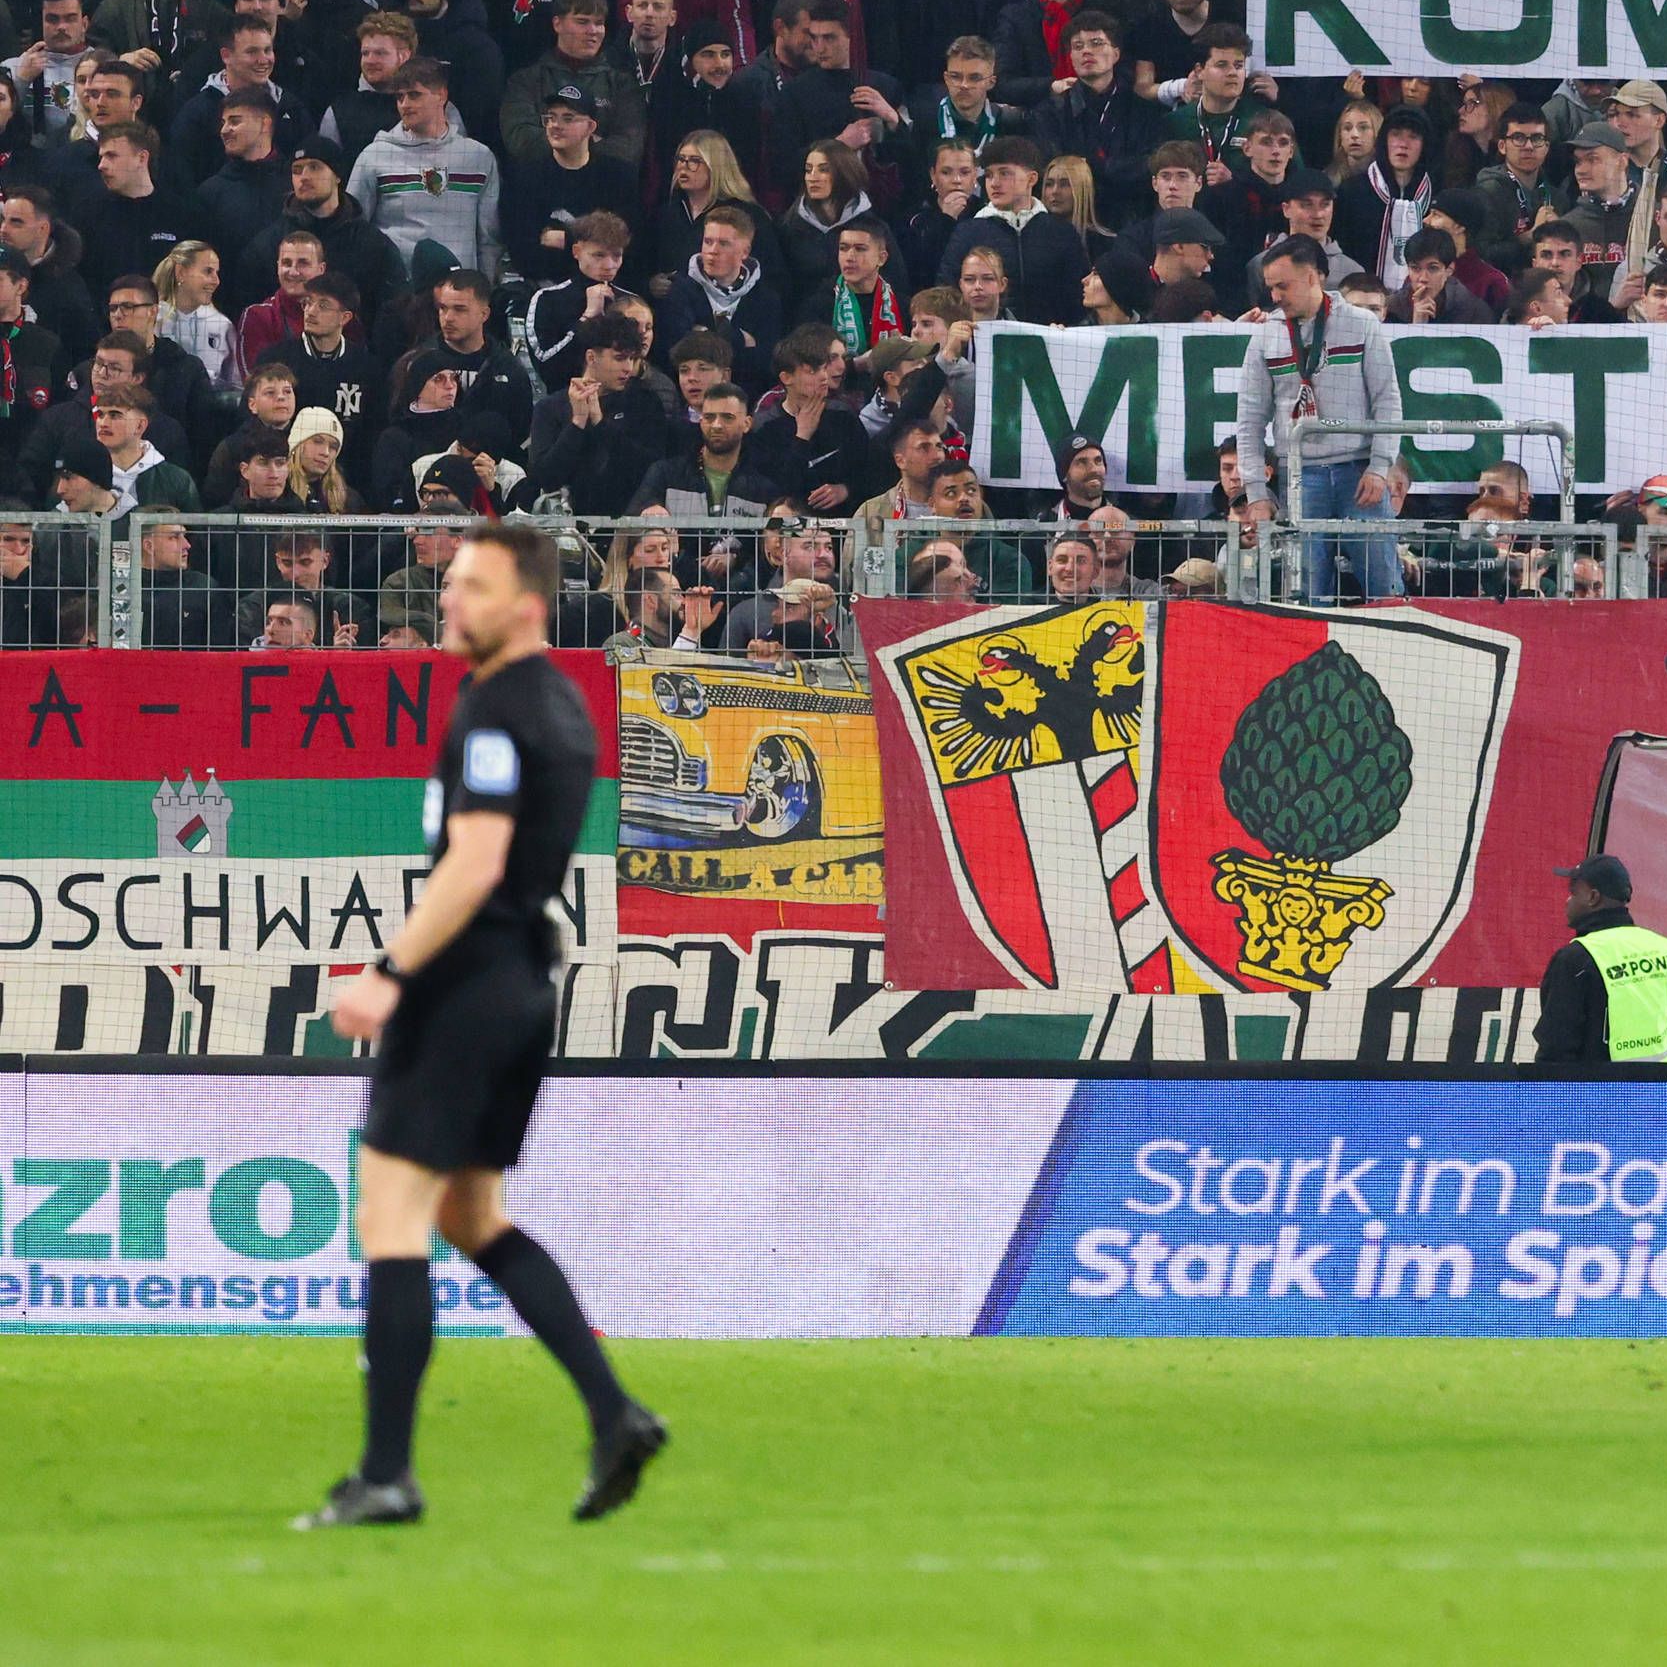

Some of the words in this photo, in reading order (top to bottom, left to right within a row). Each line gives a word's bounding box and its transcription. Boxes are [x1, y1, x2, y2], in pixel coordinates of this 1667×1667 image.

[335, 382, 362, 417] NY
[618, 849, 732, 889] CALL
[751, 863, 775, 893] A
[789, 864, 885, 898] CAB
[1615, 1034, 1663, 1052] ORDNUNG
[1124, 1136, 1378, 1217] Stark
[1397, 1135, 1518, 1216] im
[1068, 1225, 1332, 1300] Stark
[1351, 1219, 1473, 1299] im
